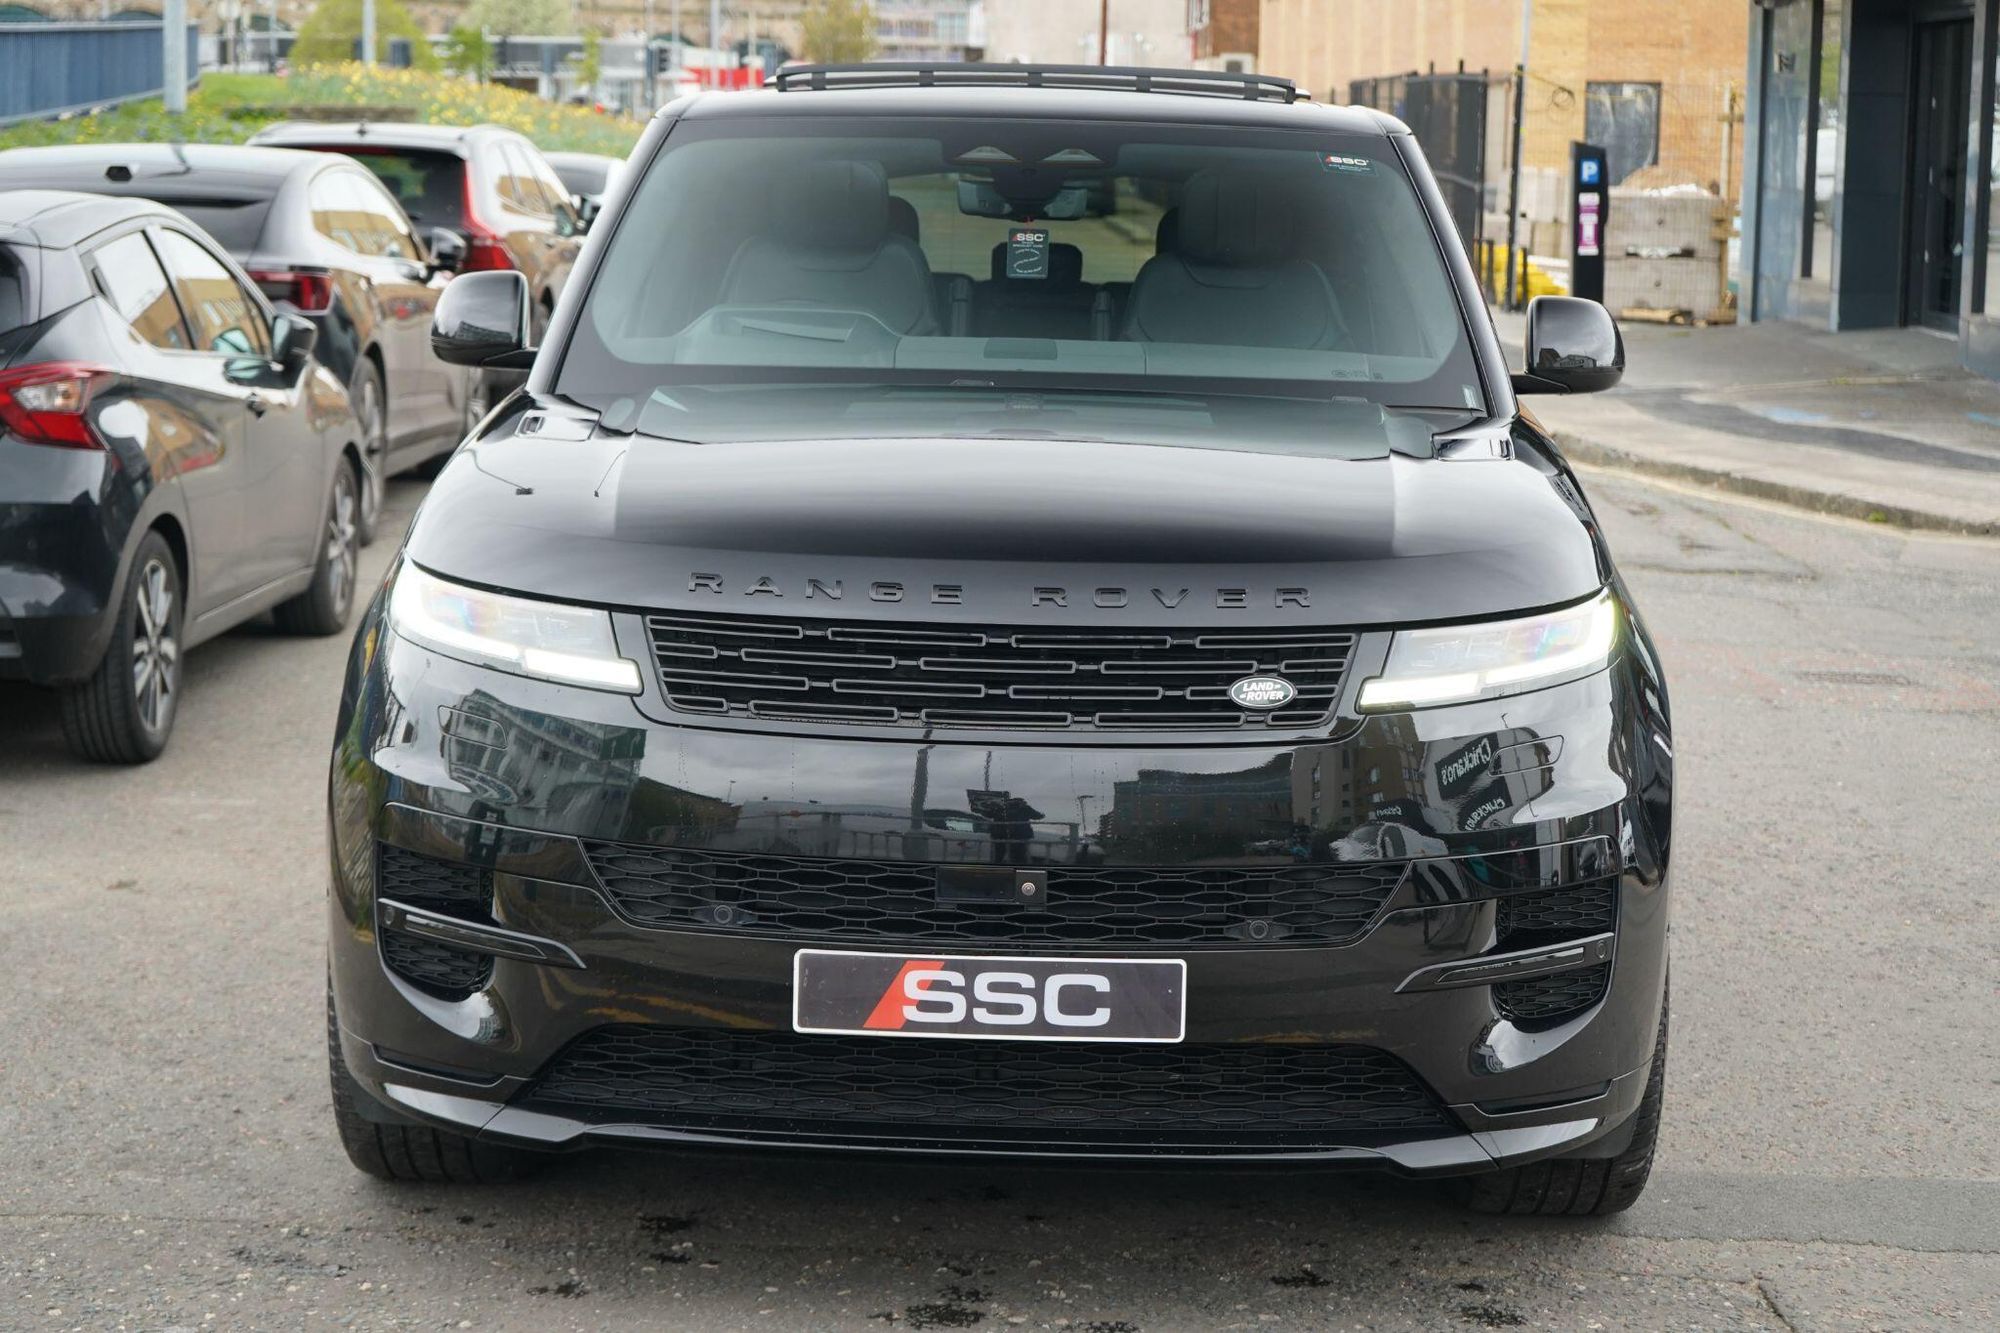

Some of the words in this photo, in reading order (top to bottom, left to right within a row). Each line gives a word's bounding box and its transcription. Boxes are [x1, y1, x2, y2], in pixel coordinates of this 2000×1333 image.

[1582, 161, 1598, 182] P
[1016, 233, 1044, 242] SSC
[688, 572, 963, 605] RANGE
[1032, 587, 1311, 608] ROVER
[1243, 682, 1274, 692] LAND
[1246, 690, 1285, 701] ROVER
[902, 969, 1111, 1027] SSC
